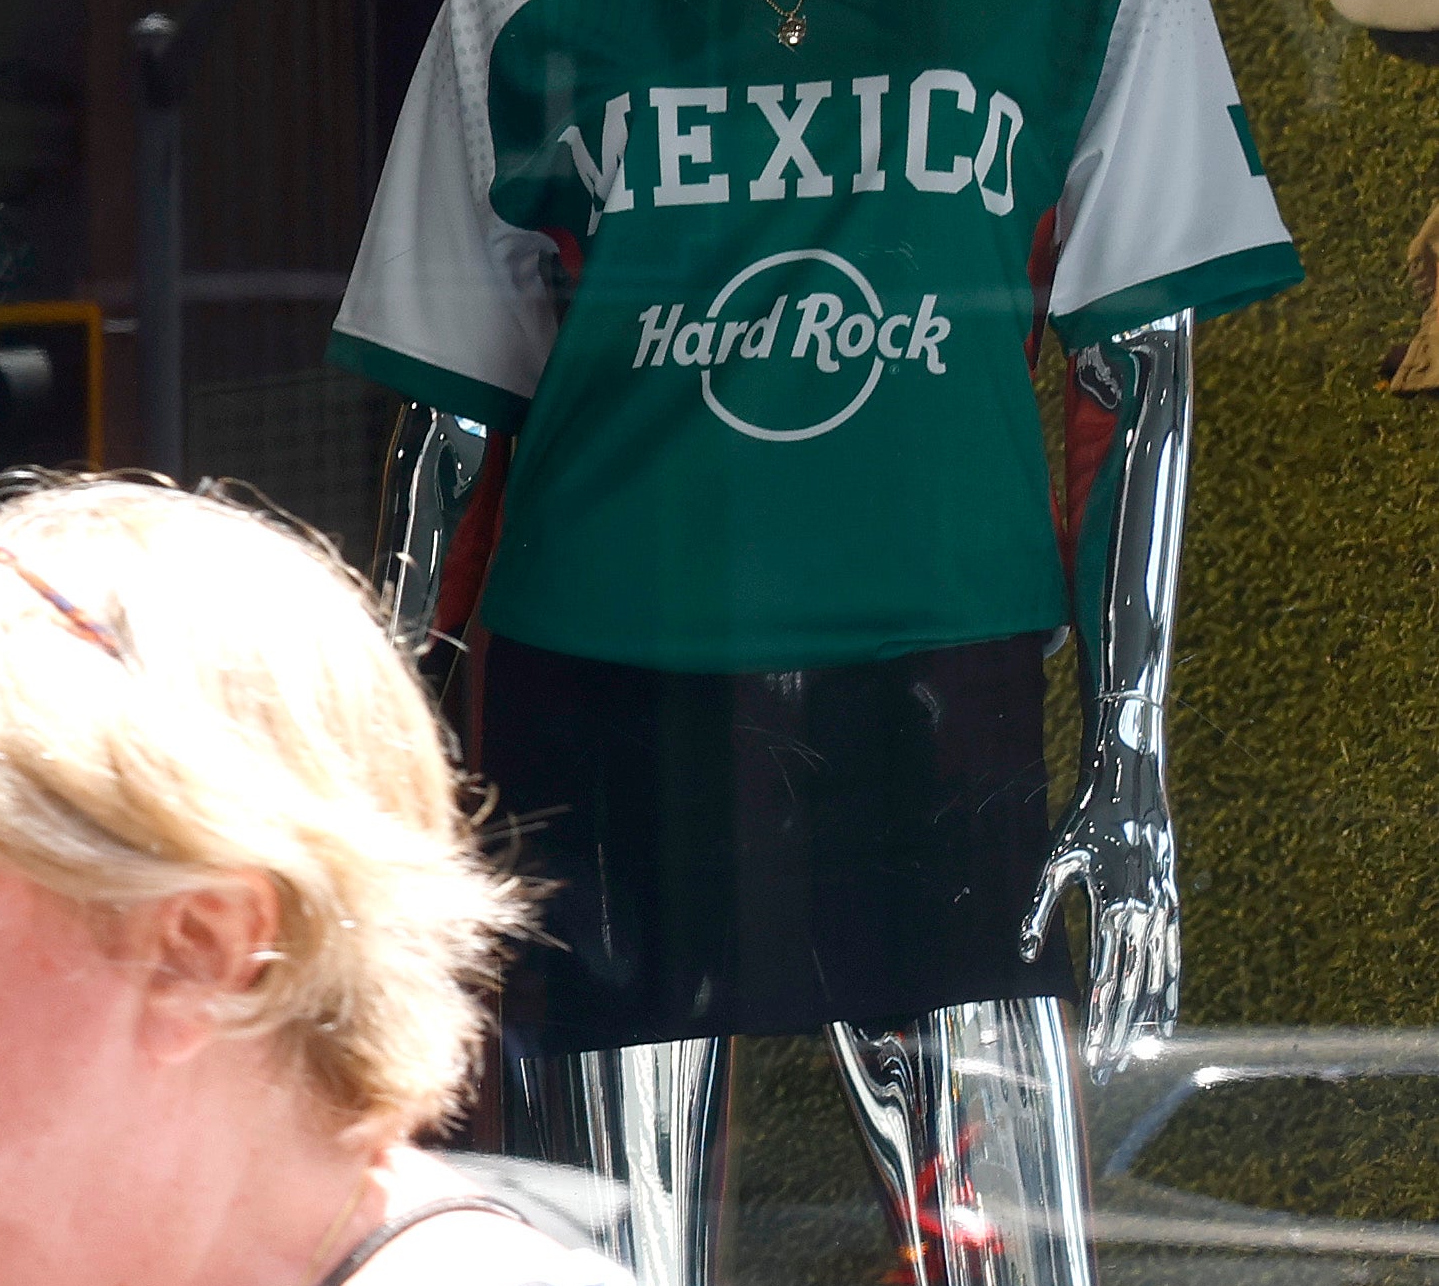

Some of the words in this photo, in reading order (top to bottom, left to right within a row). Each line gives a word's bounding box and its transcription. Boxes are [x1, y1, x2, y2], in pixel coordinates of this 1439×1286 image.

[557, 69, 1024, 236] MEXICO
[632, 295, 787, 369] Hard
[790, 292, 952, 376] Rock
